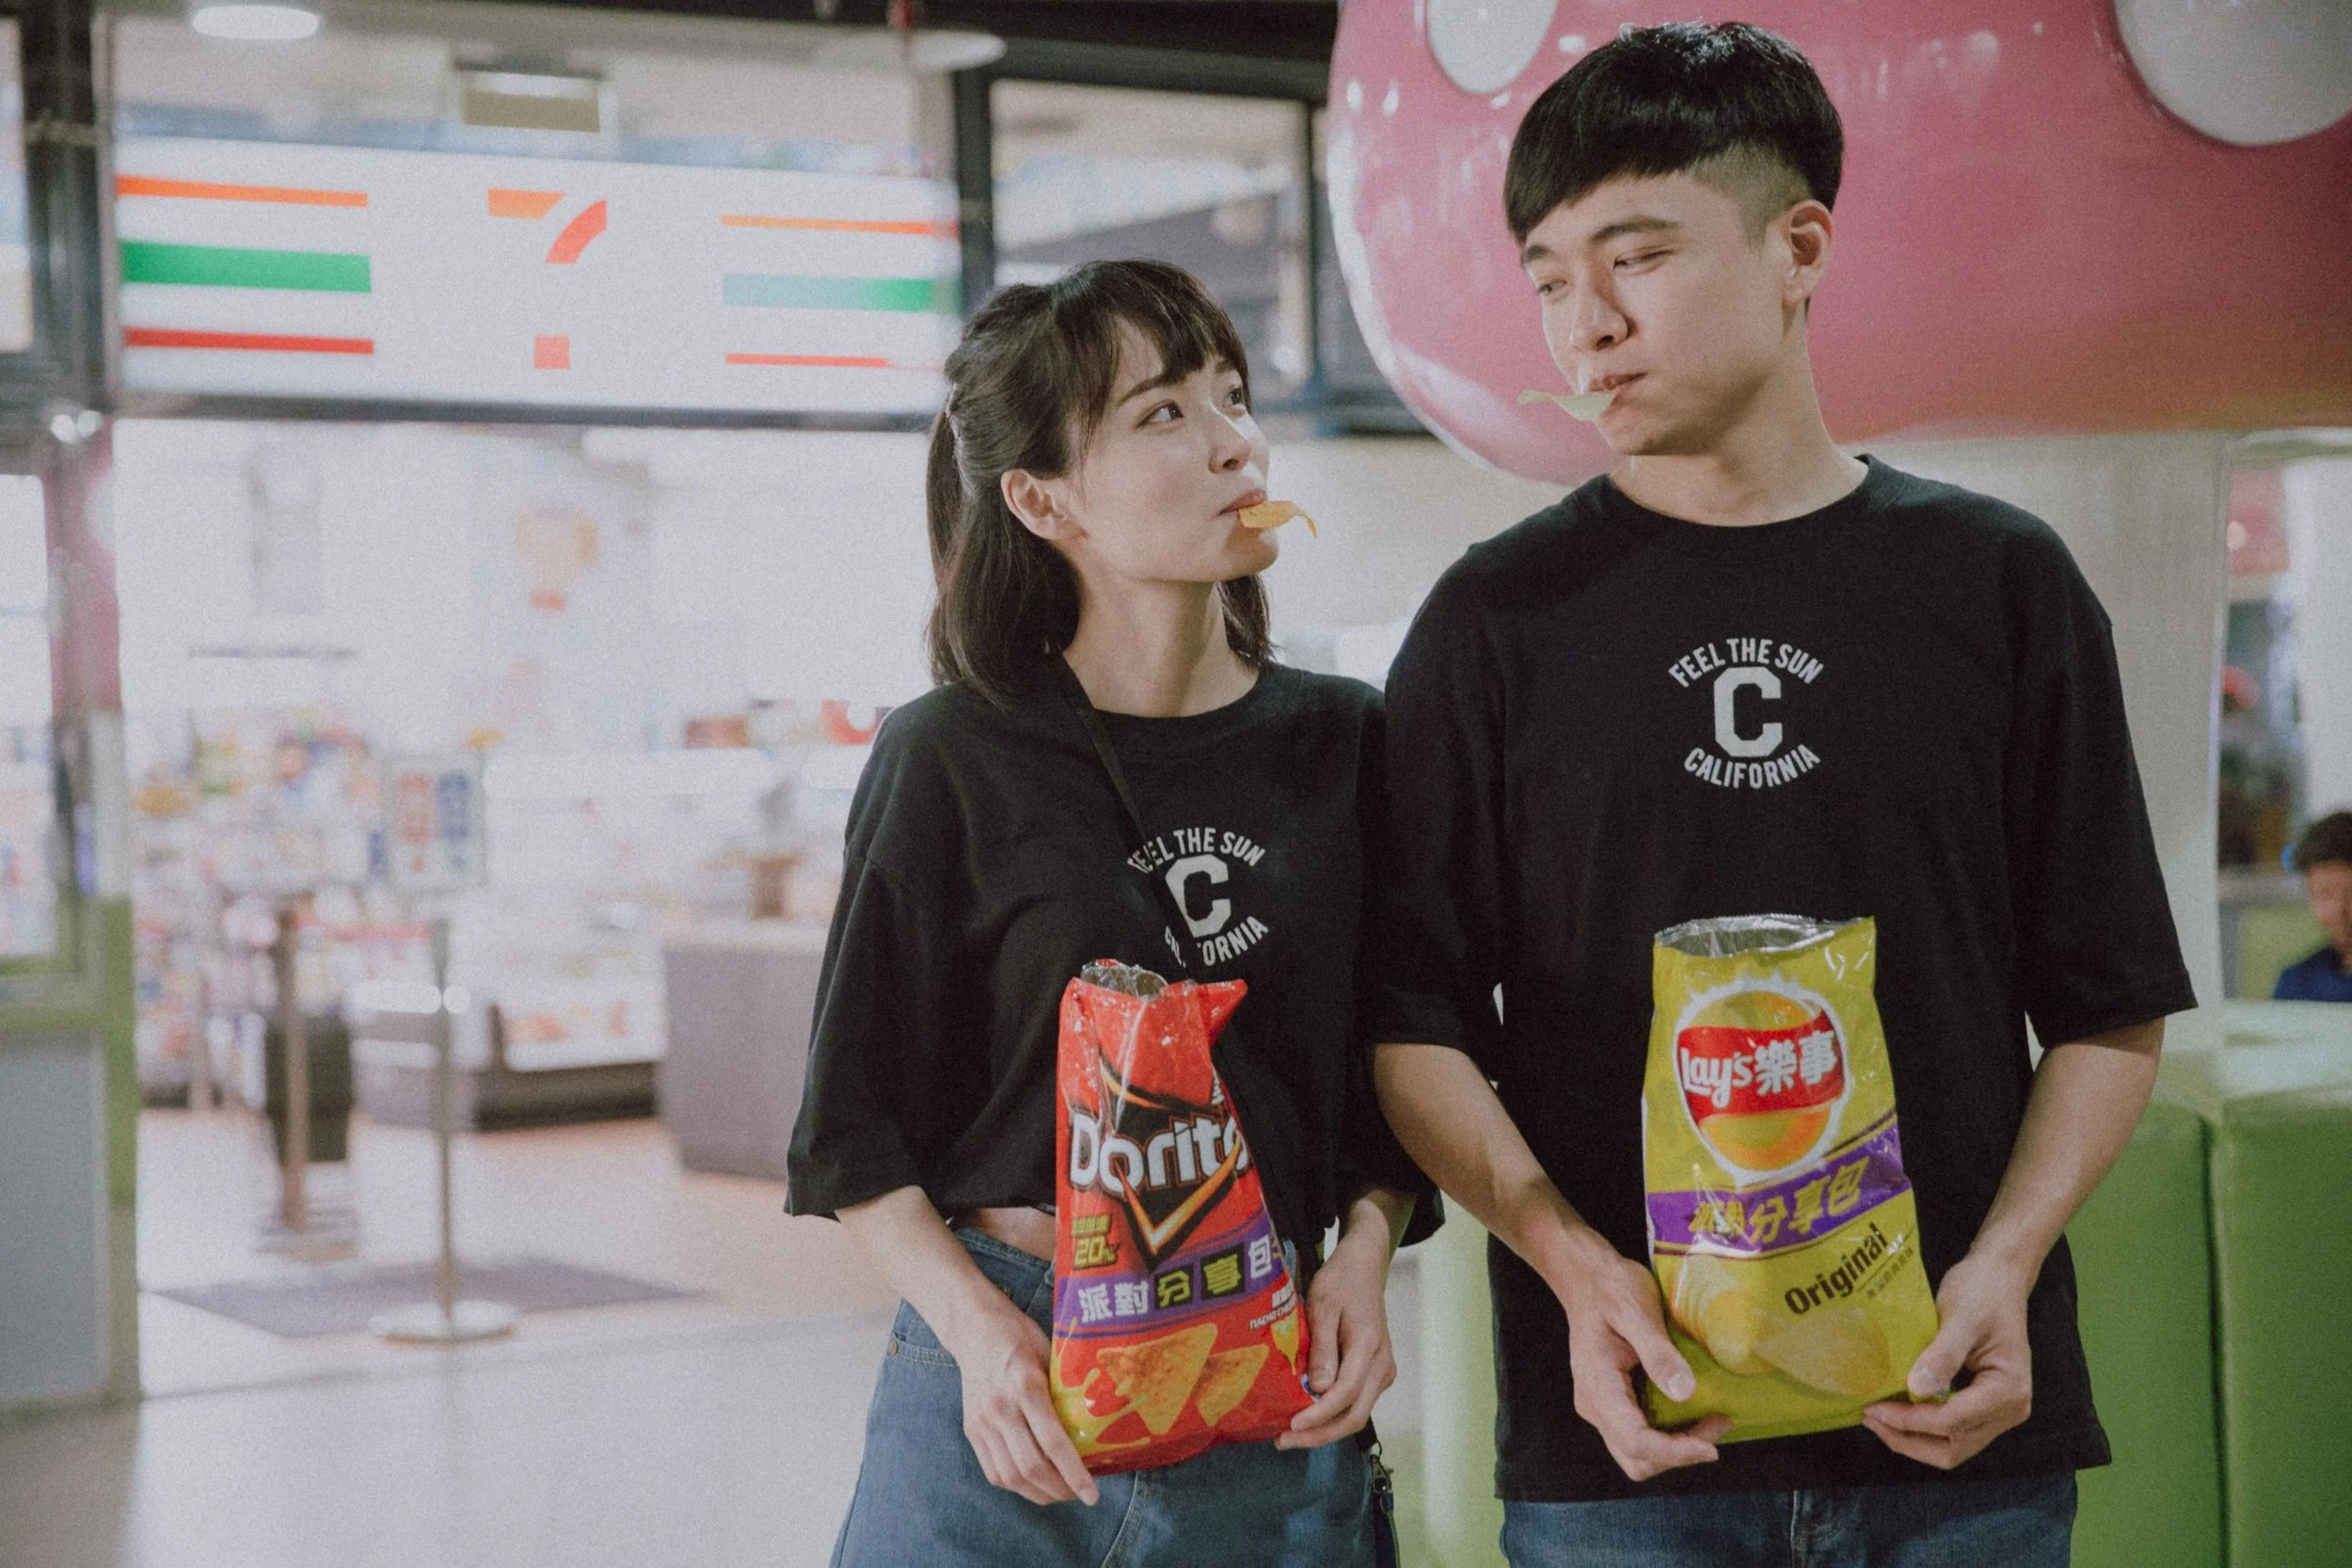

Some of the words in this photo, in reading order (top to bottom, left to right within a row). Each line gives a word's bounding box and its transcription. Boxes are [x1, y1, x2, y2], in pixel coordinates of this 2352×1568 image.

[1668, 642, 1726, 689] FEEL
[1726, 638, 1773, 665] THE
[1774, 643, 1825, 685] SUN
[1713, 666, 1784, 758] C
[1684, 743, 1821, 789] CALIFORNIA
[1173, 827, 1216, 855] THE
[1219, 832, 1266, 867] SUN
[1165, 853, 1232, 939] C
[1680, 1046, 1754, 1109] Lay's
[1755, 1029, 1836, 1095] 樂事
[1078, 1234, 1273, 1323] 派對分享包
[1784, 1222, 1888, 1315] Original
